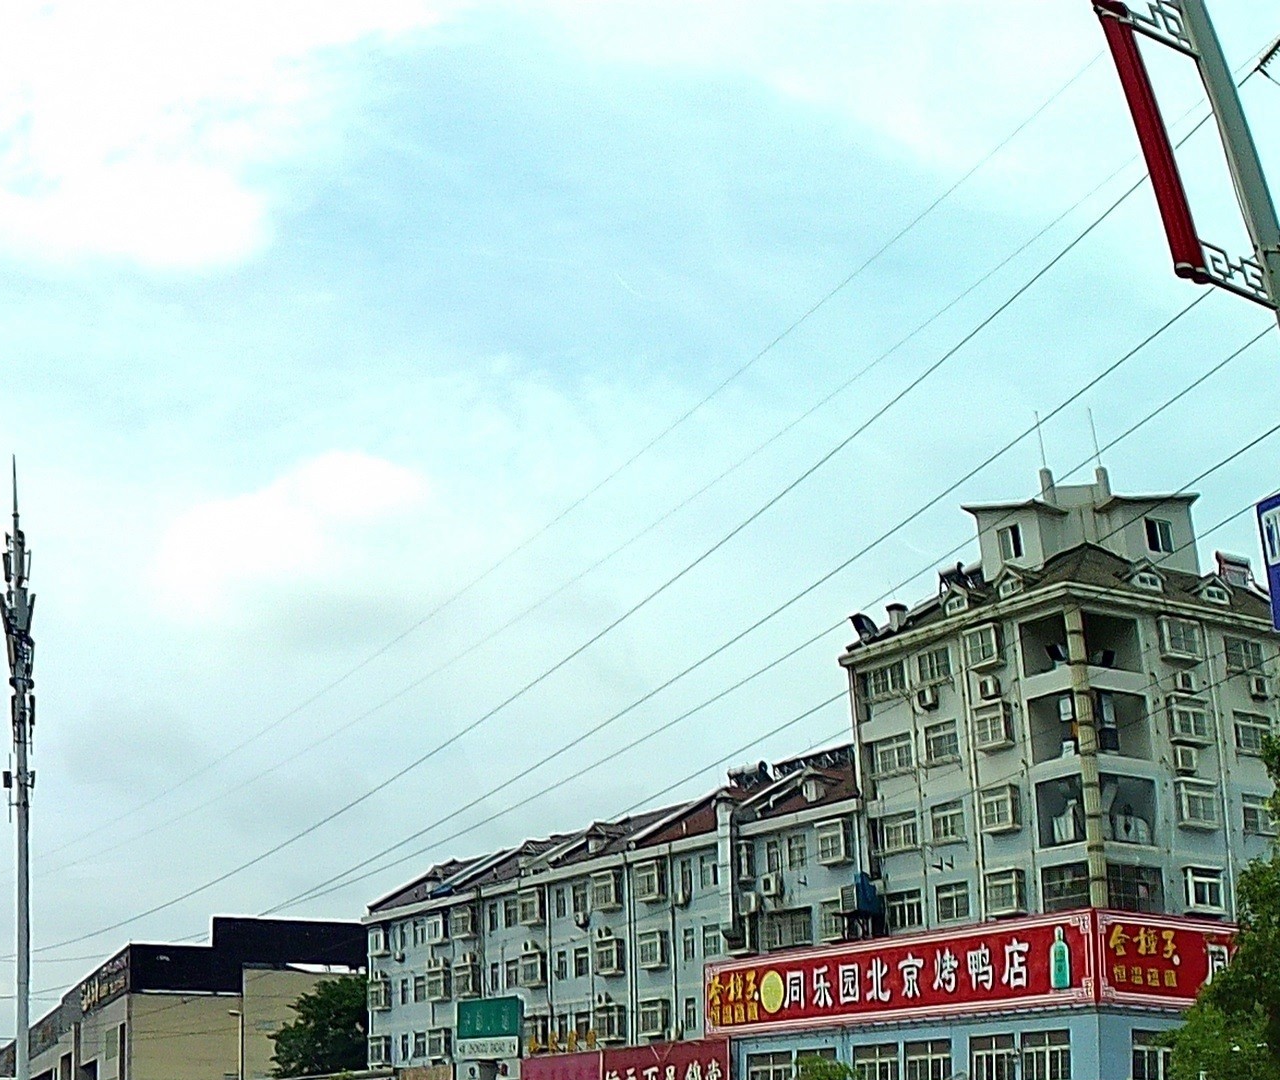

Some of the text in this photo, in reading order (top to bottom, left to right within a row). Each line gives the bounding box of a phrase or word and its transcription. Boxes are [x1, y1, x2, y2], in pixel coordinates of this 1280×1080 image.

[784, 937, 1030, 1010] 同乐园北京烤鸭店
